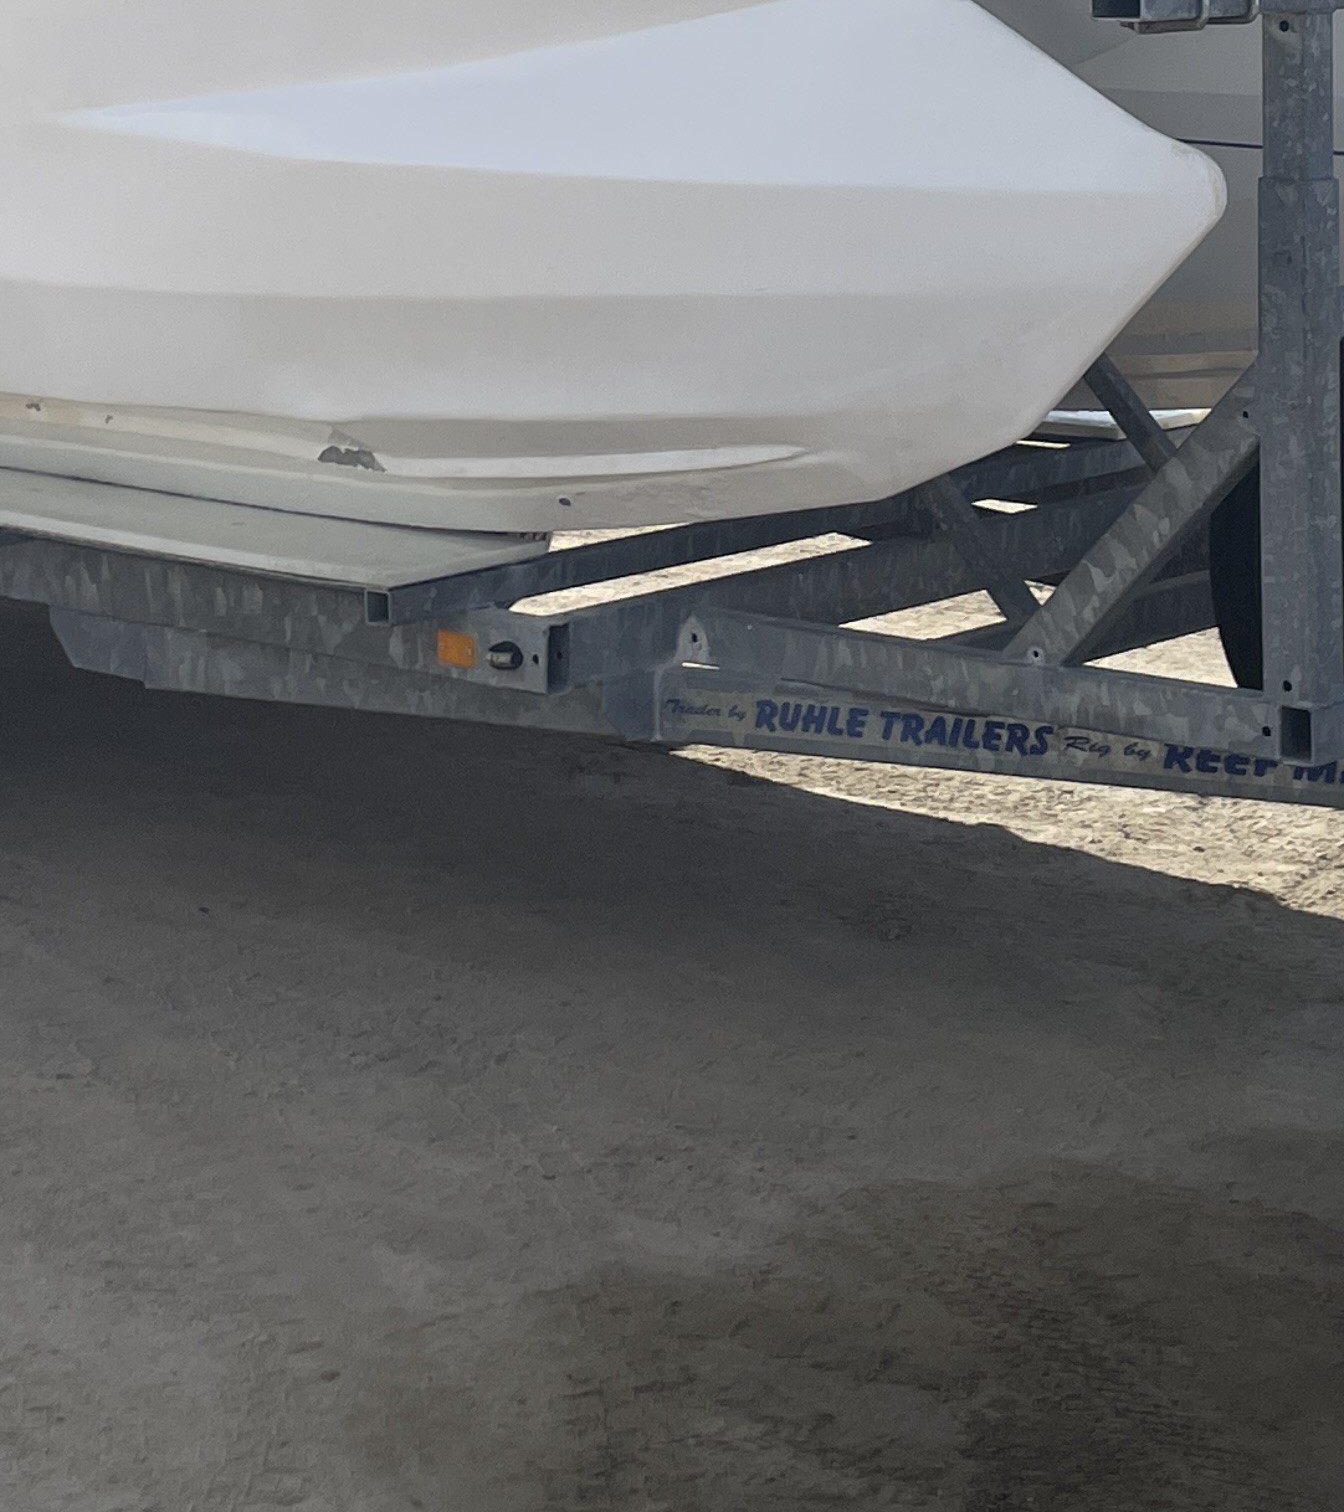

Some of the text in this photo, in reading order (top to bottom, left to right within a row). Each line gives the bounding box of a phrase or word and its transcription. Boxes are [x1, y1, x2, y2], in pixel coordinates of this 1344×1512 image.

[727, 704, 748, 722] by
[755, 698, 870, 740] RUHLE
[880, 708, 1055, 757] TRAILERS
[1063, 735, 1111, 759] Rig
[1122, 741, 1152, 762] by
